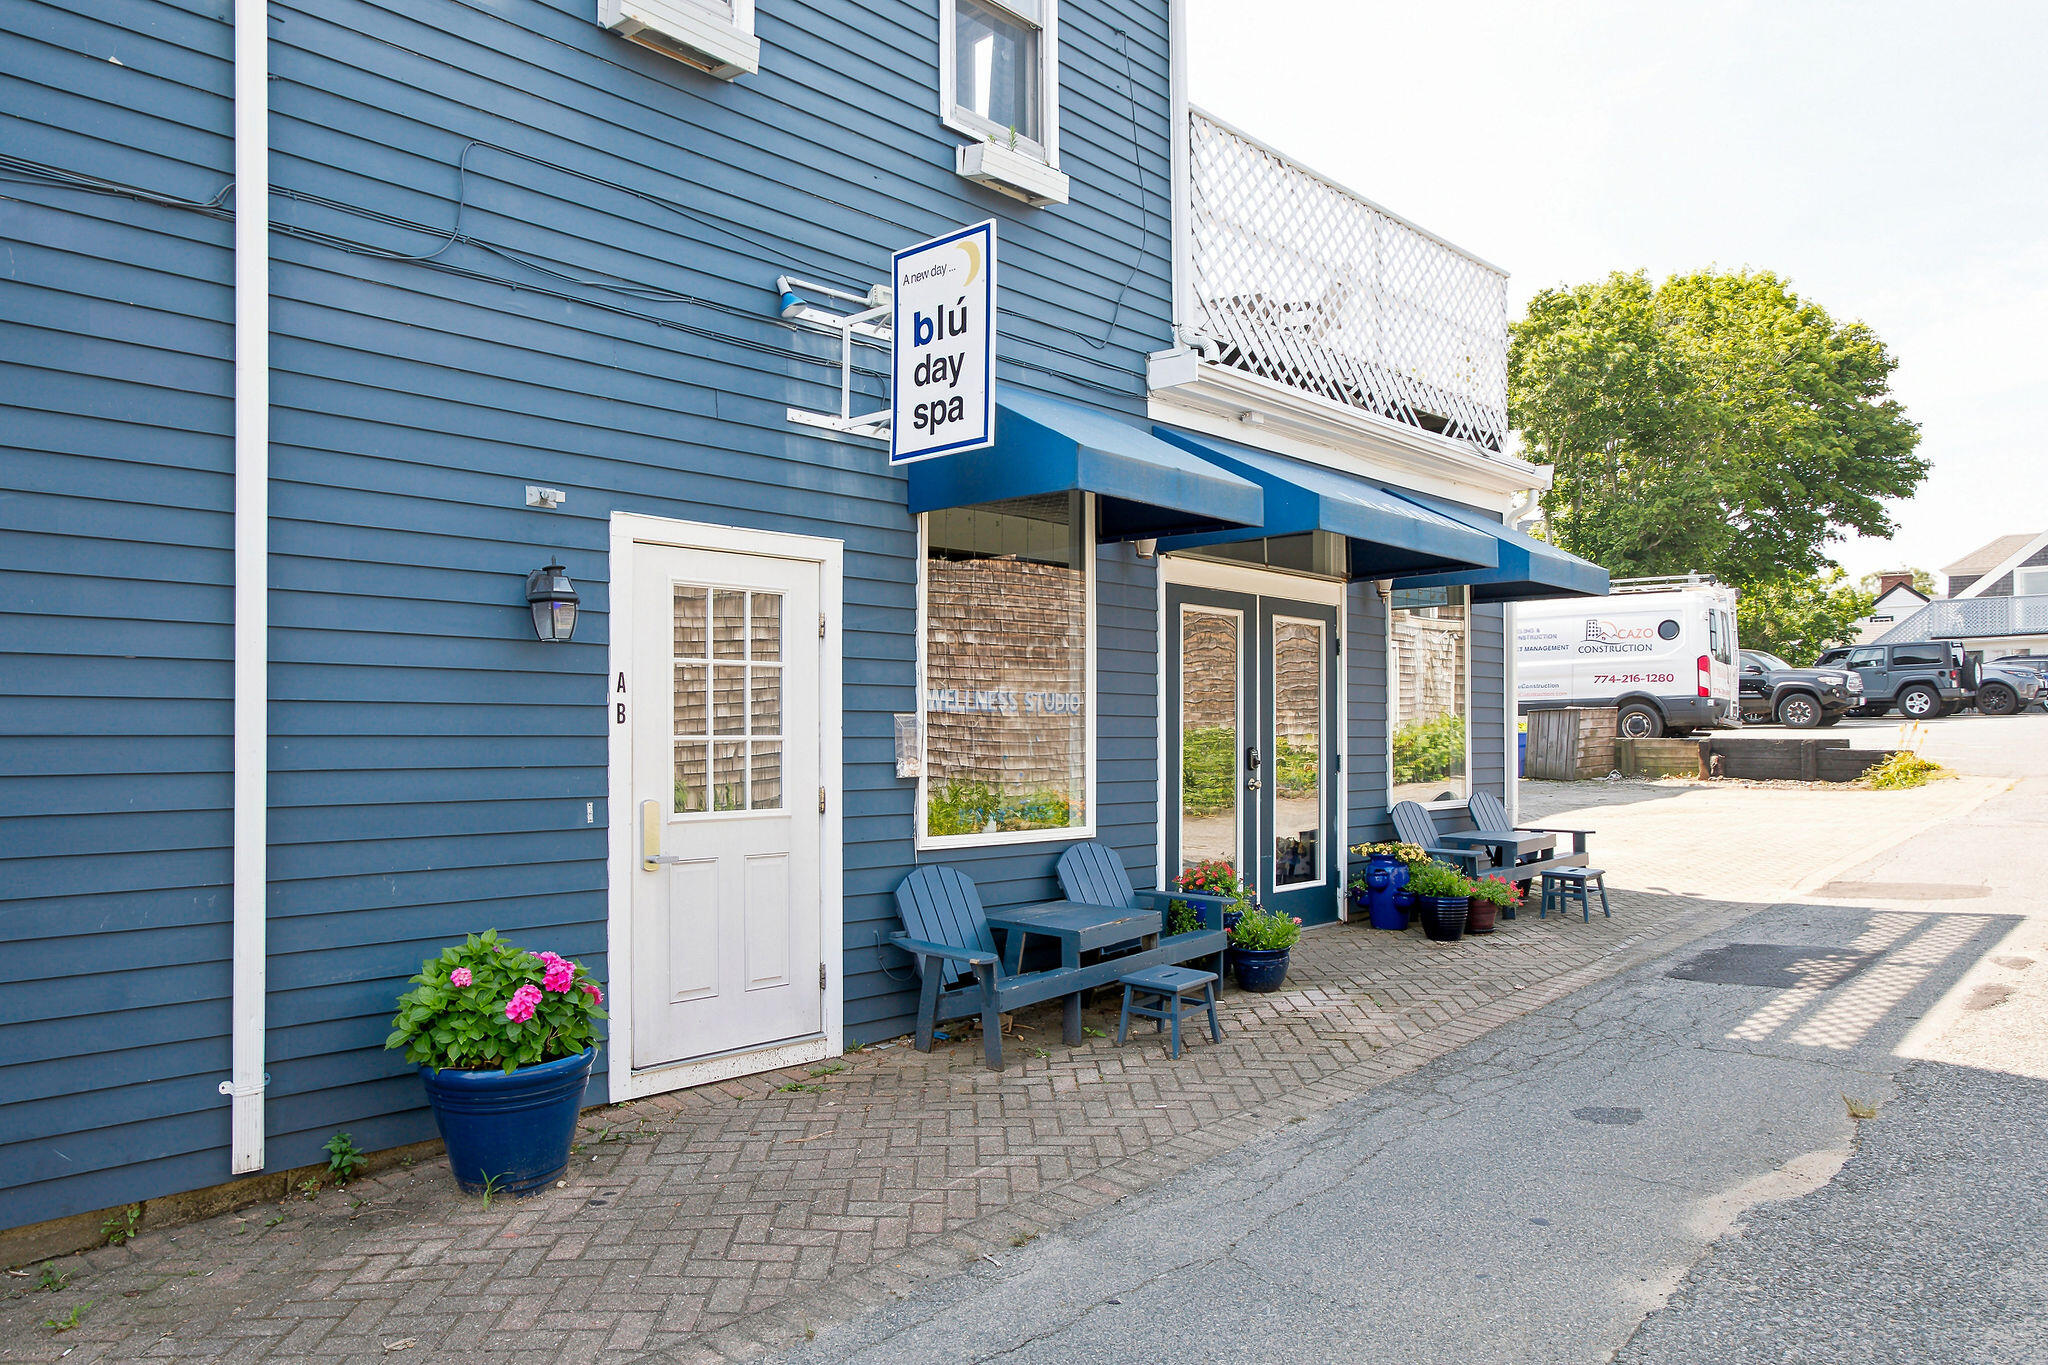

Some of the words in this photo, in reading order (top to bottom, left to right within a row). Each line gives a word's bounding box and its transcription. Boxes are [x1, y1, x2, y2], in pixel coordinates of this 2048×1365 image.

[903, 274, 910, 286] A
[910, 270, 930, 283] new
[913, 295, 968, 347] blú
[914, 351, 965, 388] day
[913, 395, 965, 435] spa
[1577, 643, 1653, 654] CONSTRUCTION
[617, 672, 626, 693] A
[1594, 673, 1675, 684] 774-216-1280
[927, 689, 1018, 712] WELLNESS
[1024, 691, 1081, 714] STUDIO
[617, 703, 626, 724] B
